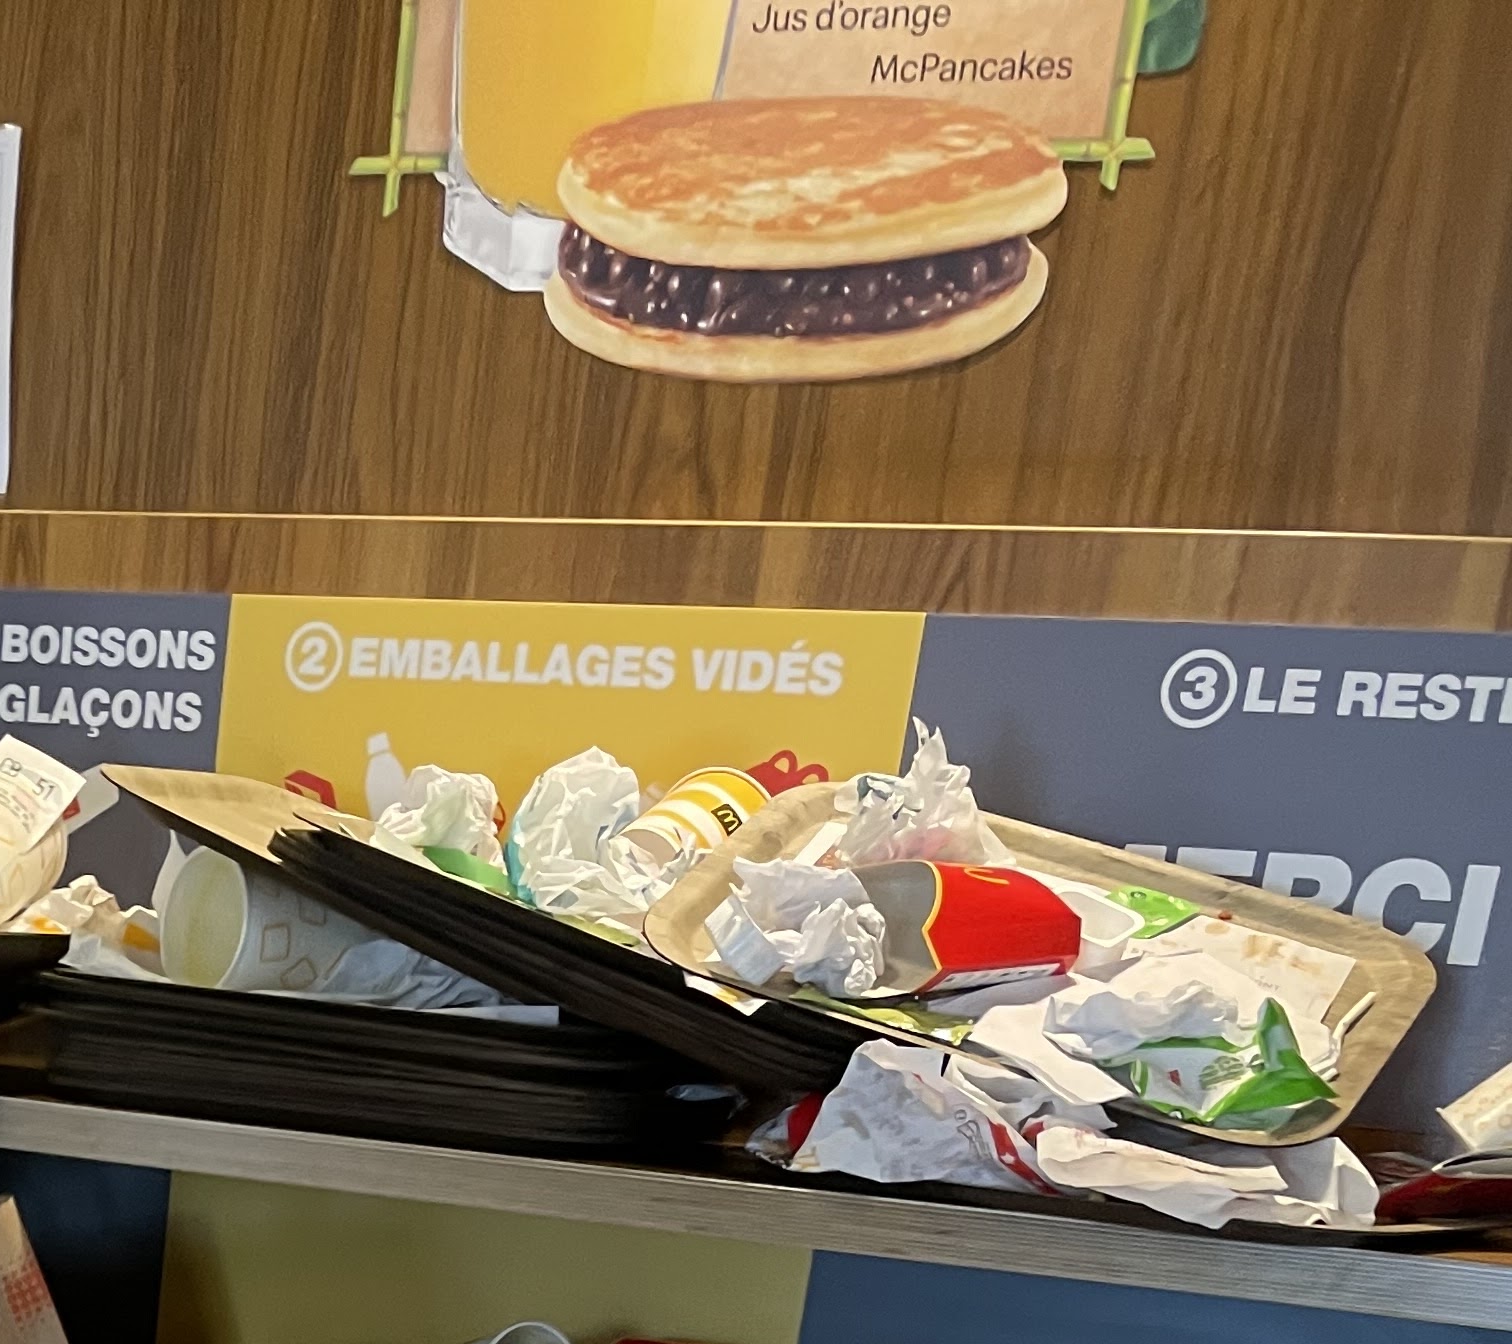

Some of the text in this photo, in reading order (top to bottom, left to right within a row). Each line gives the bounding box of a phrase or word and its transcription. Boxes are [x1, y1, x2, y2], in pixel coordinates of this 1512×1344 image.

[752, 0, 951, 37] Jus d'orange
[870, 50, 1073, 84] McPancakes
[0, 623, 217, 671] BOISSONS
[348, 637, 675, 690] EMBALLAGES
[692, 641, 844, 696] VIDÉS
[1242, 667, 1322, 714] LE
